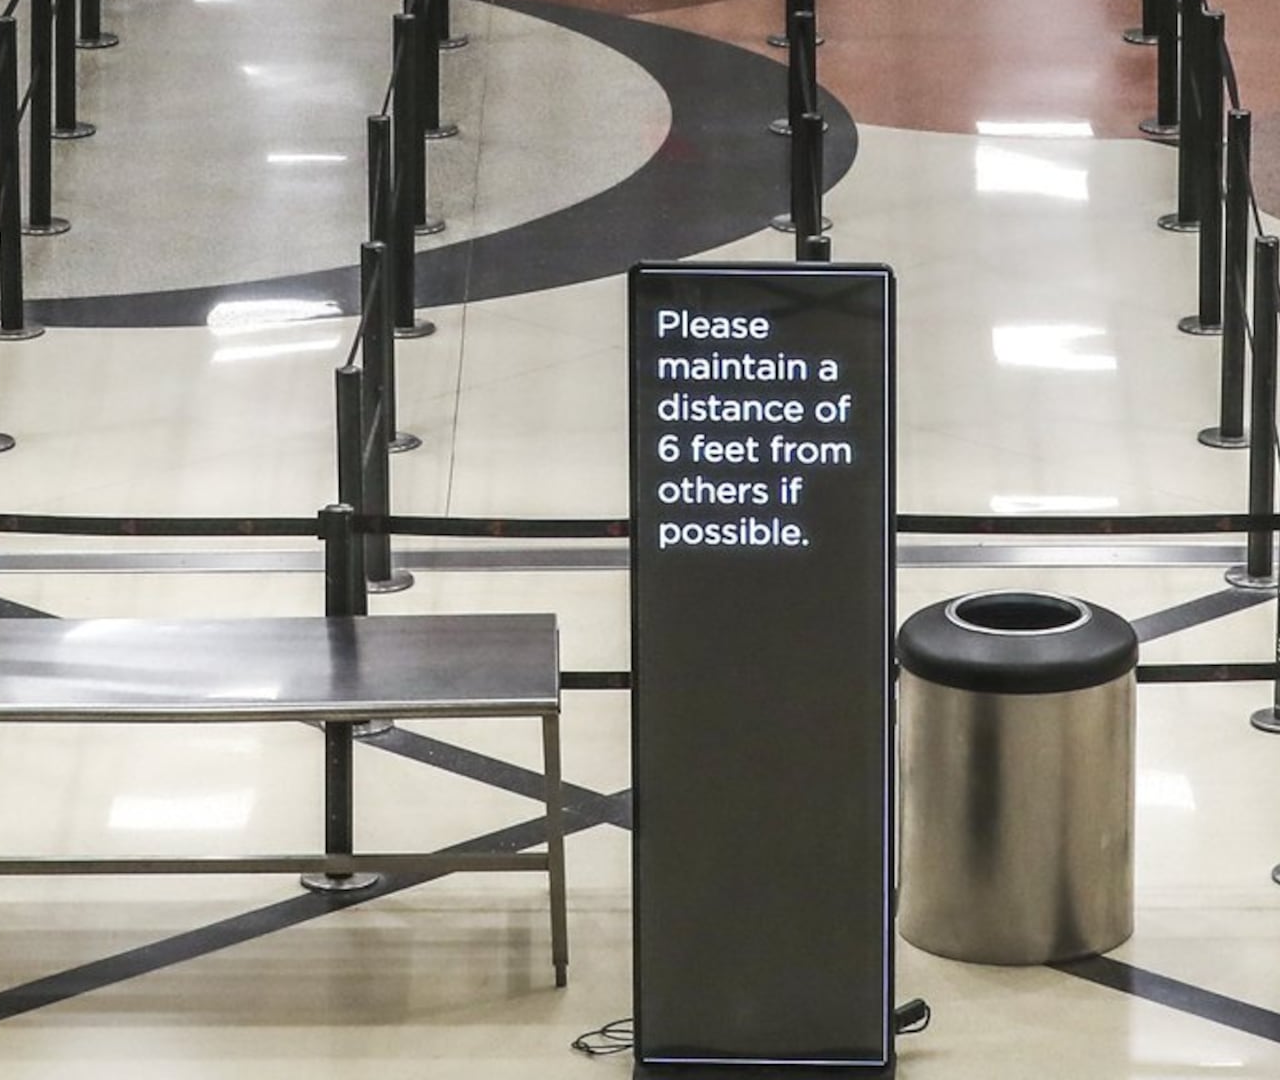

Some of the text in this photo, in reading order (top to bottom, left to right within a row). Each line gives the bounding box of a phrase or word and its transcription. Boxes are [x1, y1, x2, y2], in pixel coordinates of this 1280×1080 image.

[657, 309, 770, 339] Please
[657, 351, 838, 382] maintain a
[657, 392, 852, 423] distance of
[657, 433, 852, 464] 6 feet from
[657, 475, 804, 505] others if
[659, 516, 810, 550] possible.
